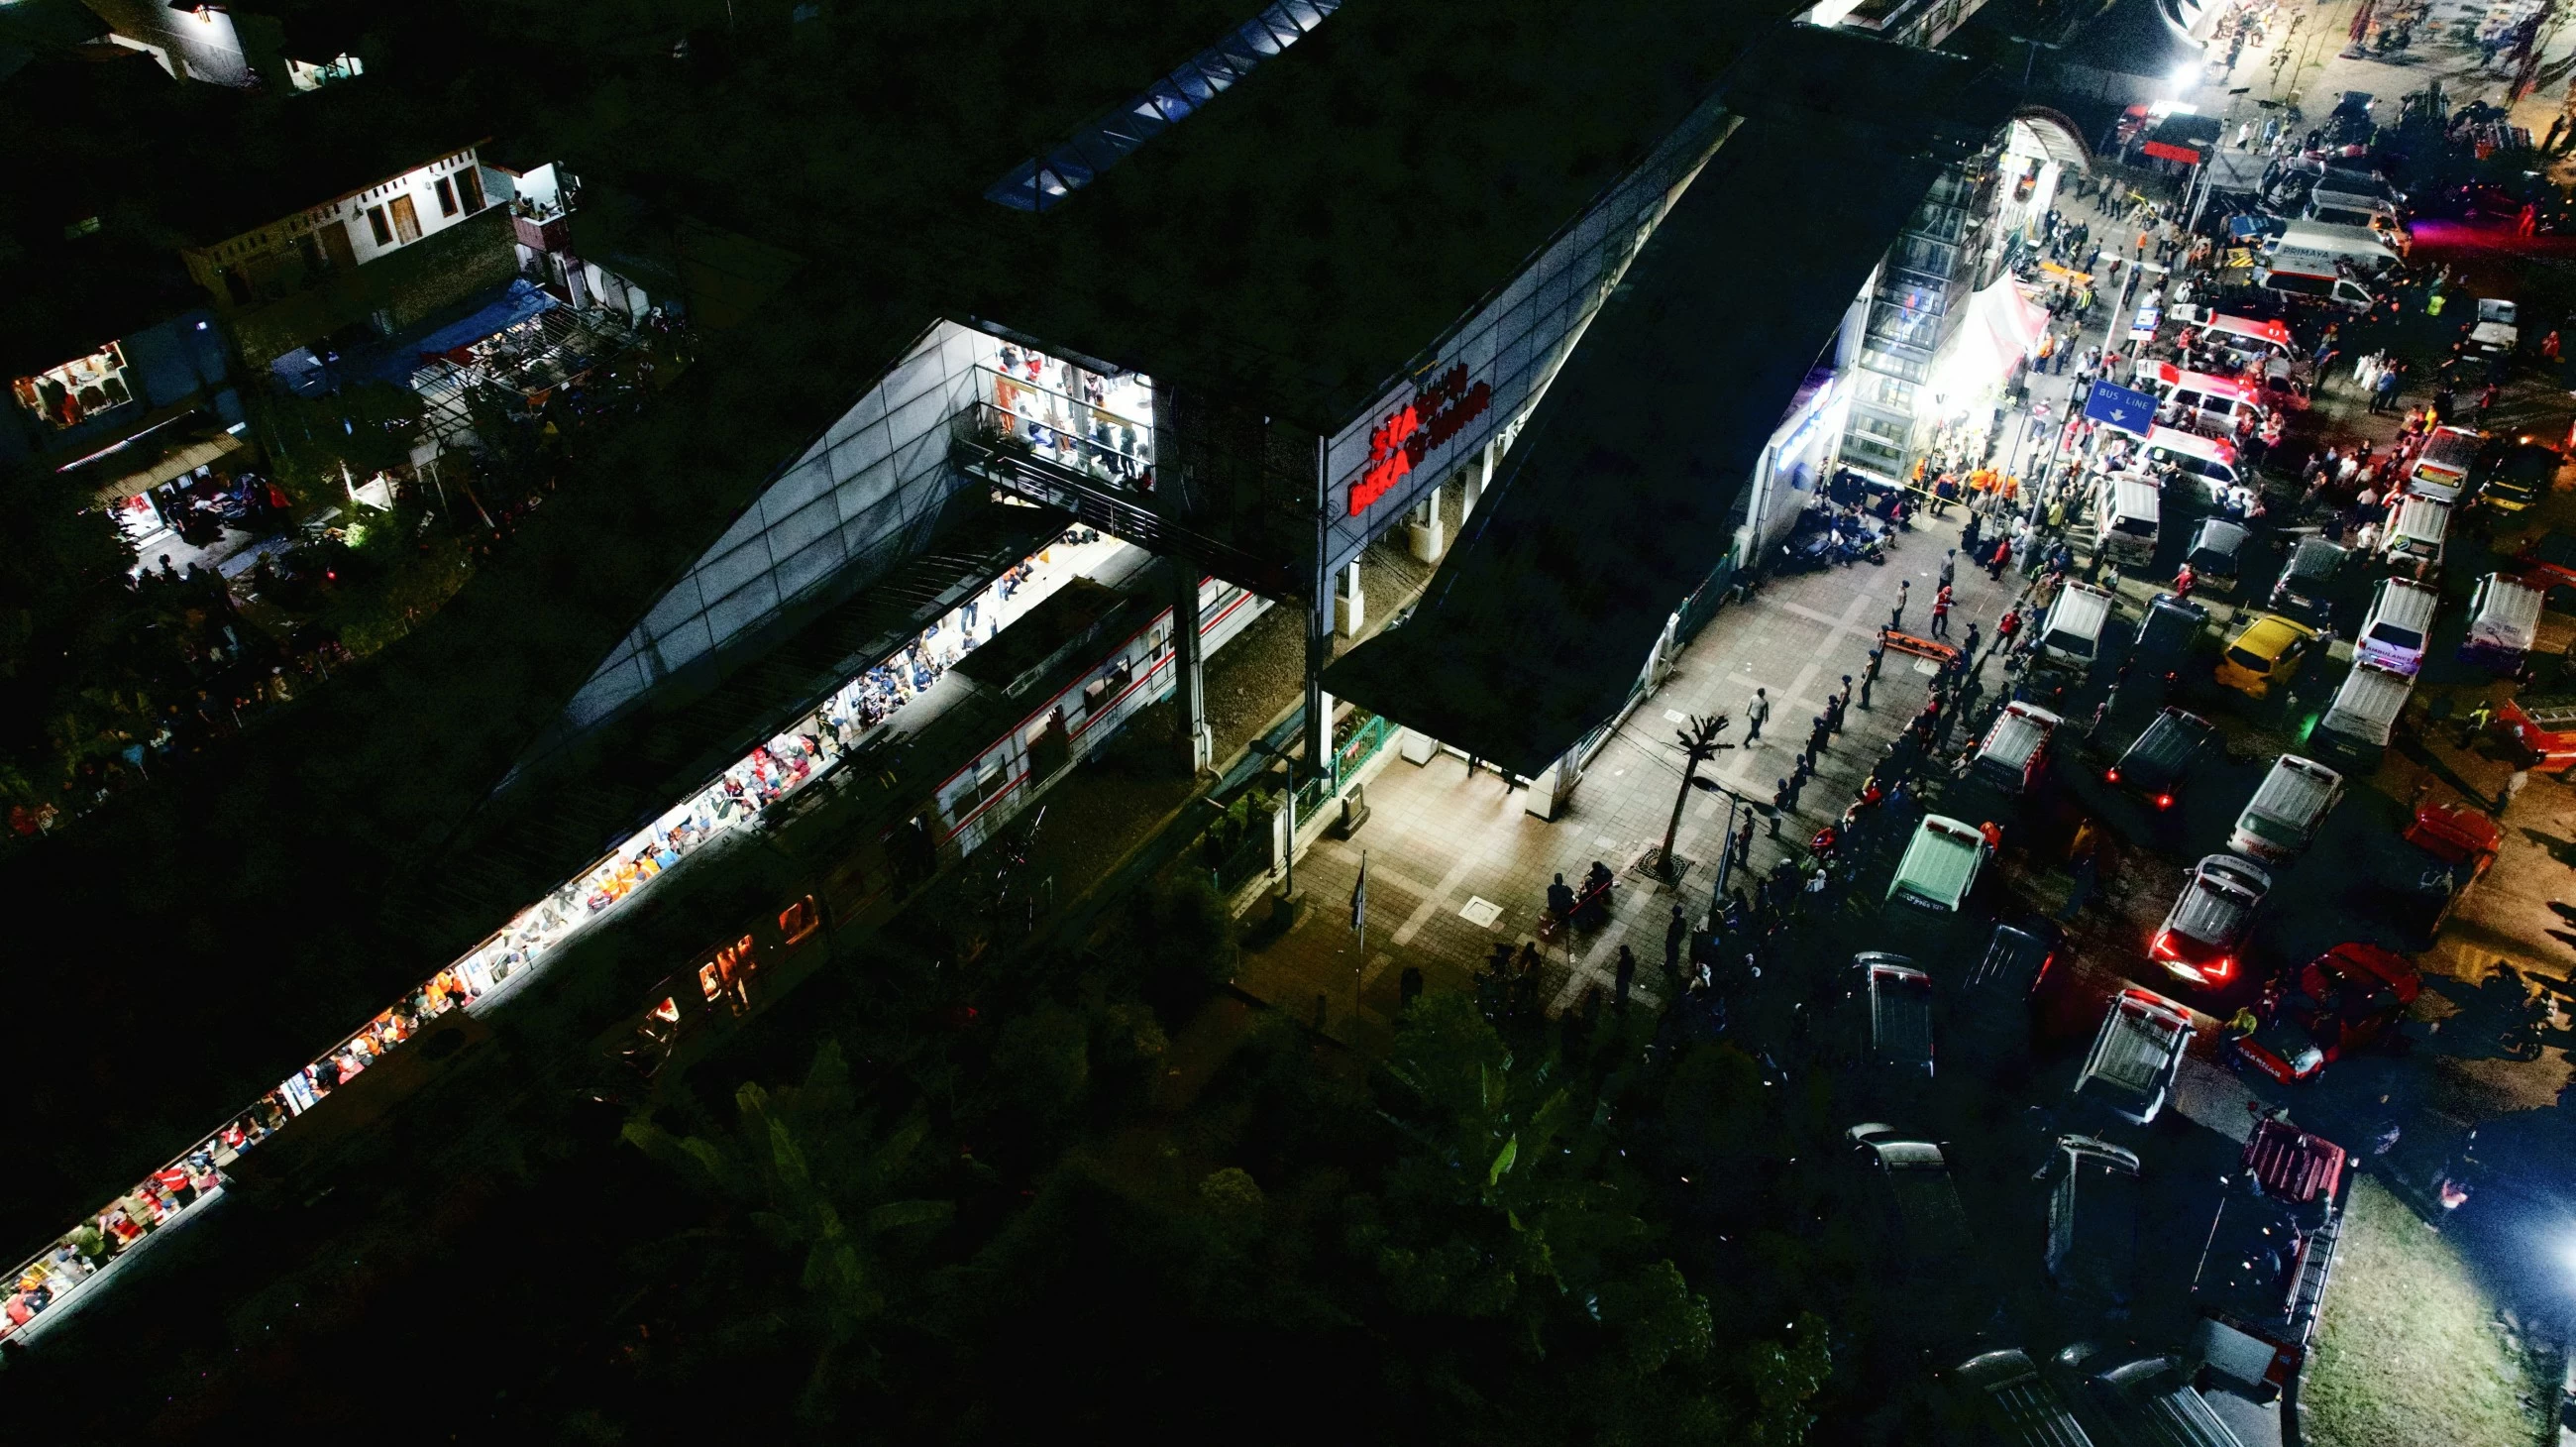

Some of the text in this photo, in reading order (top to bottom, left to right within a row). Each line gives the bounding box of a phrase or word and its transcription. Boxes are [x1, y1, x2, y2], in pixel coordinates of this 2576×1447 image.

[2283, 247, 2329, 259] PRIMAYA
[2098, 388, 2149, 410] BUS LINE
[2366, 646, 2413, 662] AMBULANCE
